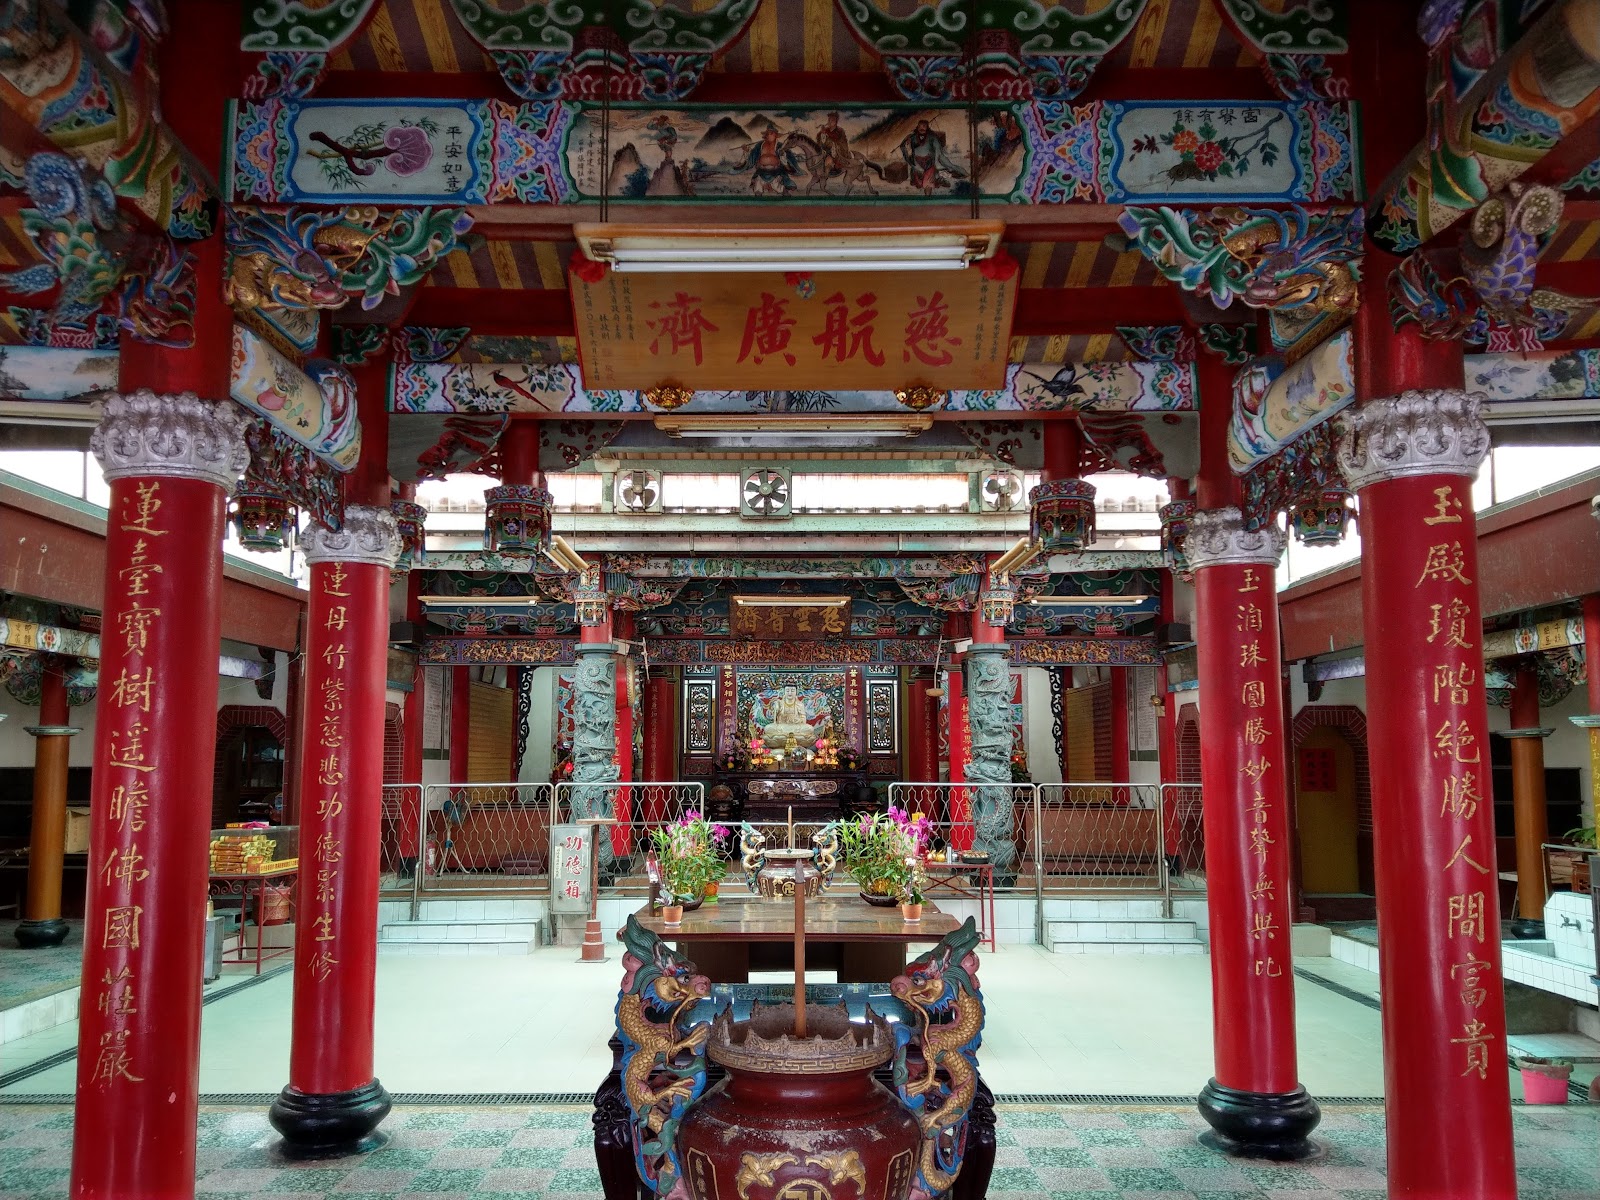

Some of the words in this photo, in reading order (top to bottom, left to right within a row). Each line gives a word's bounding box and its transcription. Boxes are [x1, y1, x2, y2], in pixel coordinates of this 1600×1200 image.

[442, 126, 463, 192] 平安如意
[645, 291, 962, 367] 慈航廣濟
[565, 835, 583, 899] 功德箱
